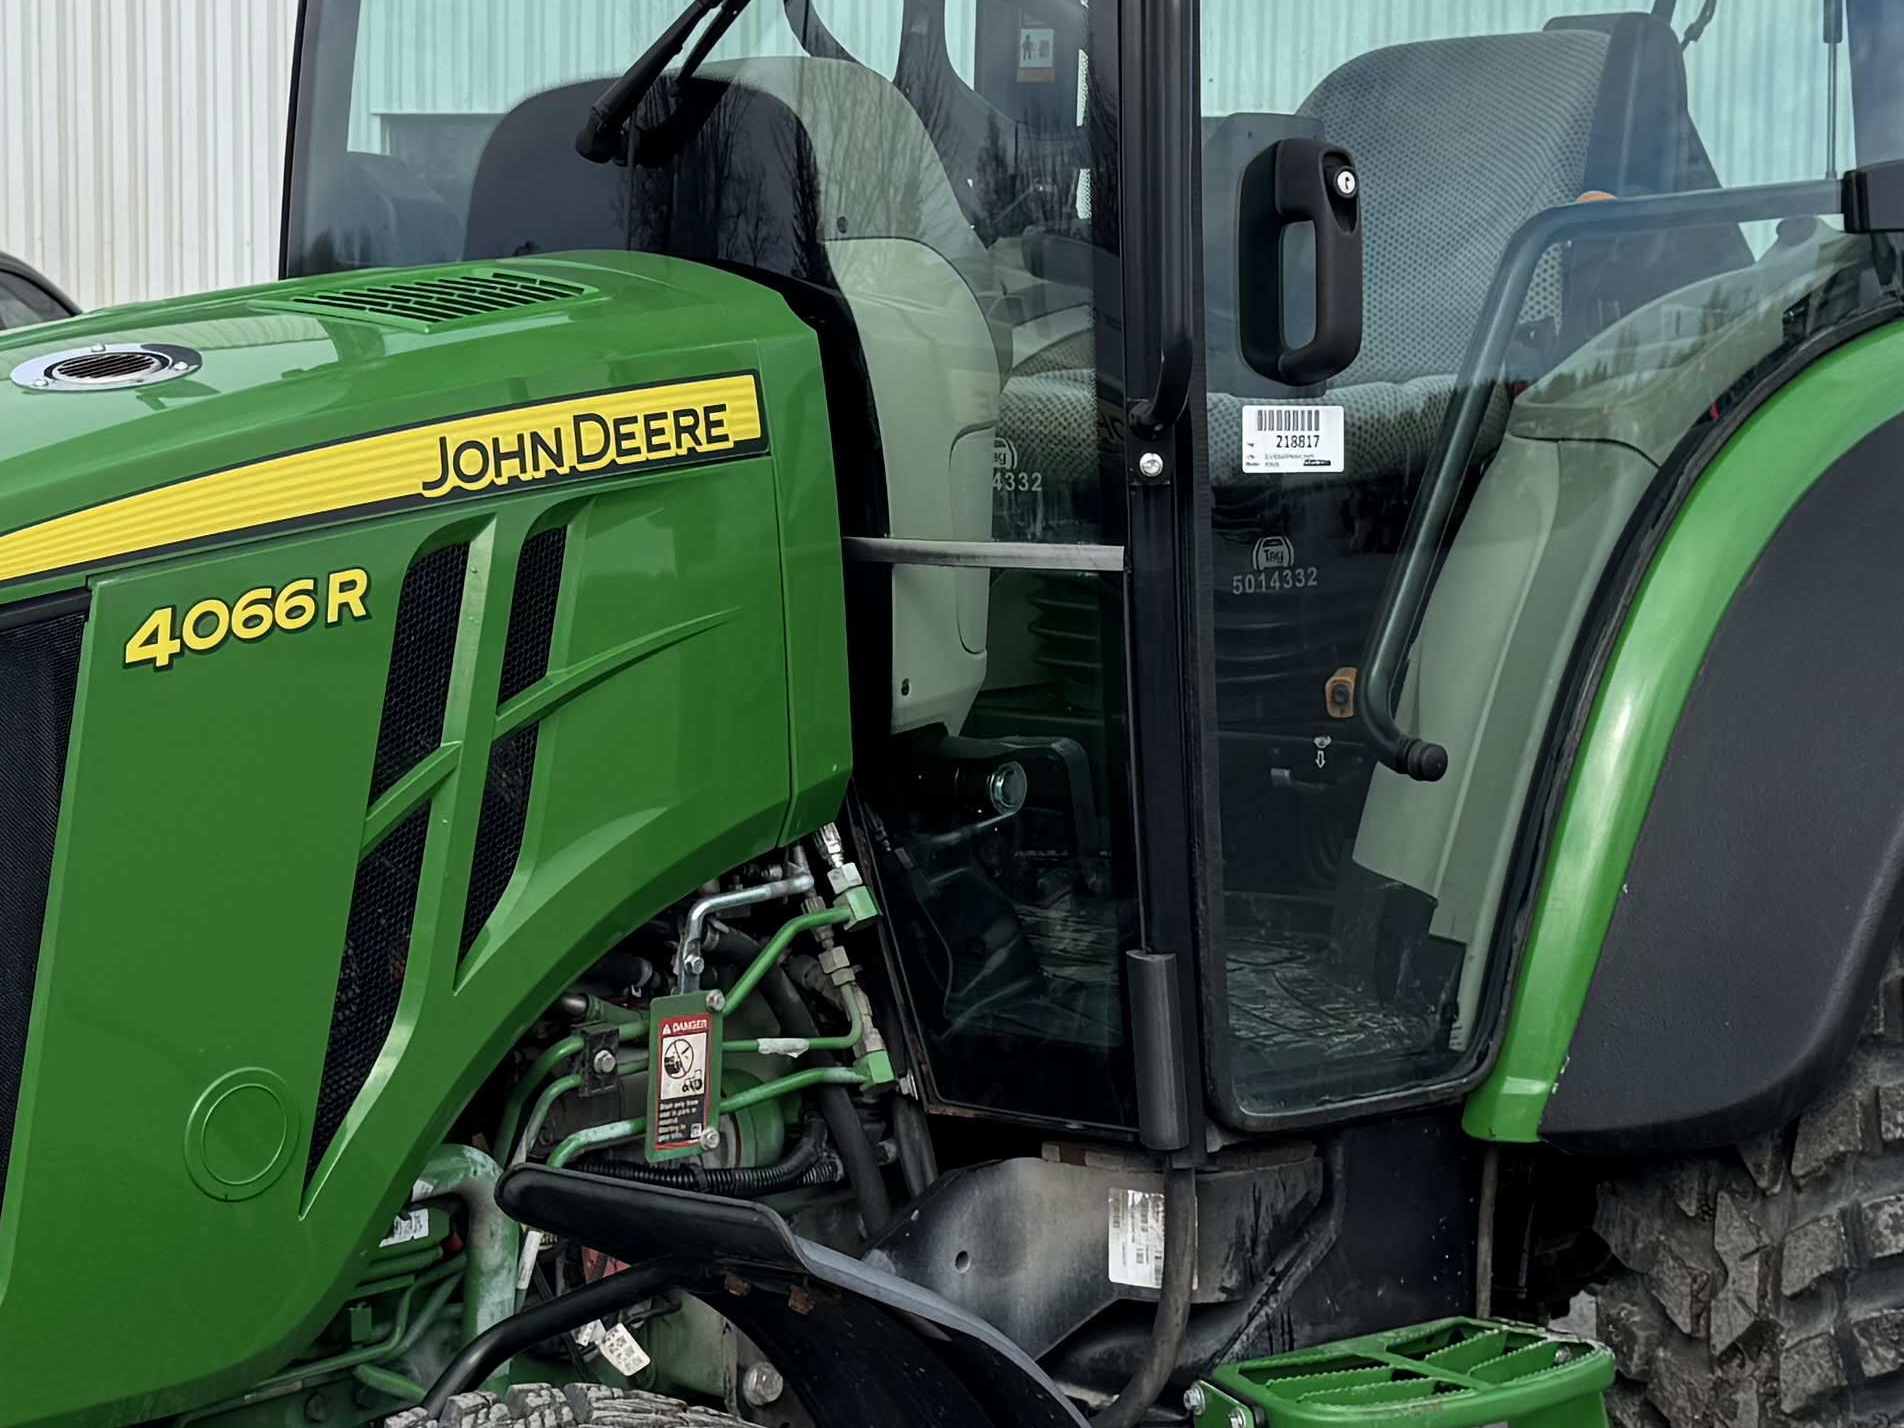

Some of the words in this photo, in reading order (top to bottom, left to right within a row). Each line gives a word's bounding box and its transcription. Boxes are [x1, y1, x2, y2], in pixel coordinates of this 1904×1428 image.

[422, 427, 564, 491] JOHN
[572, 403, 730, 465] DEERE
[1276, 434, 1320, 449] 218817
[1232, 567, 1318, 595] 5014332
